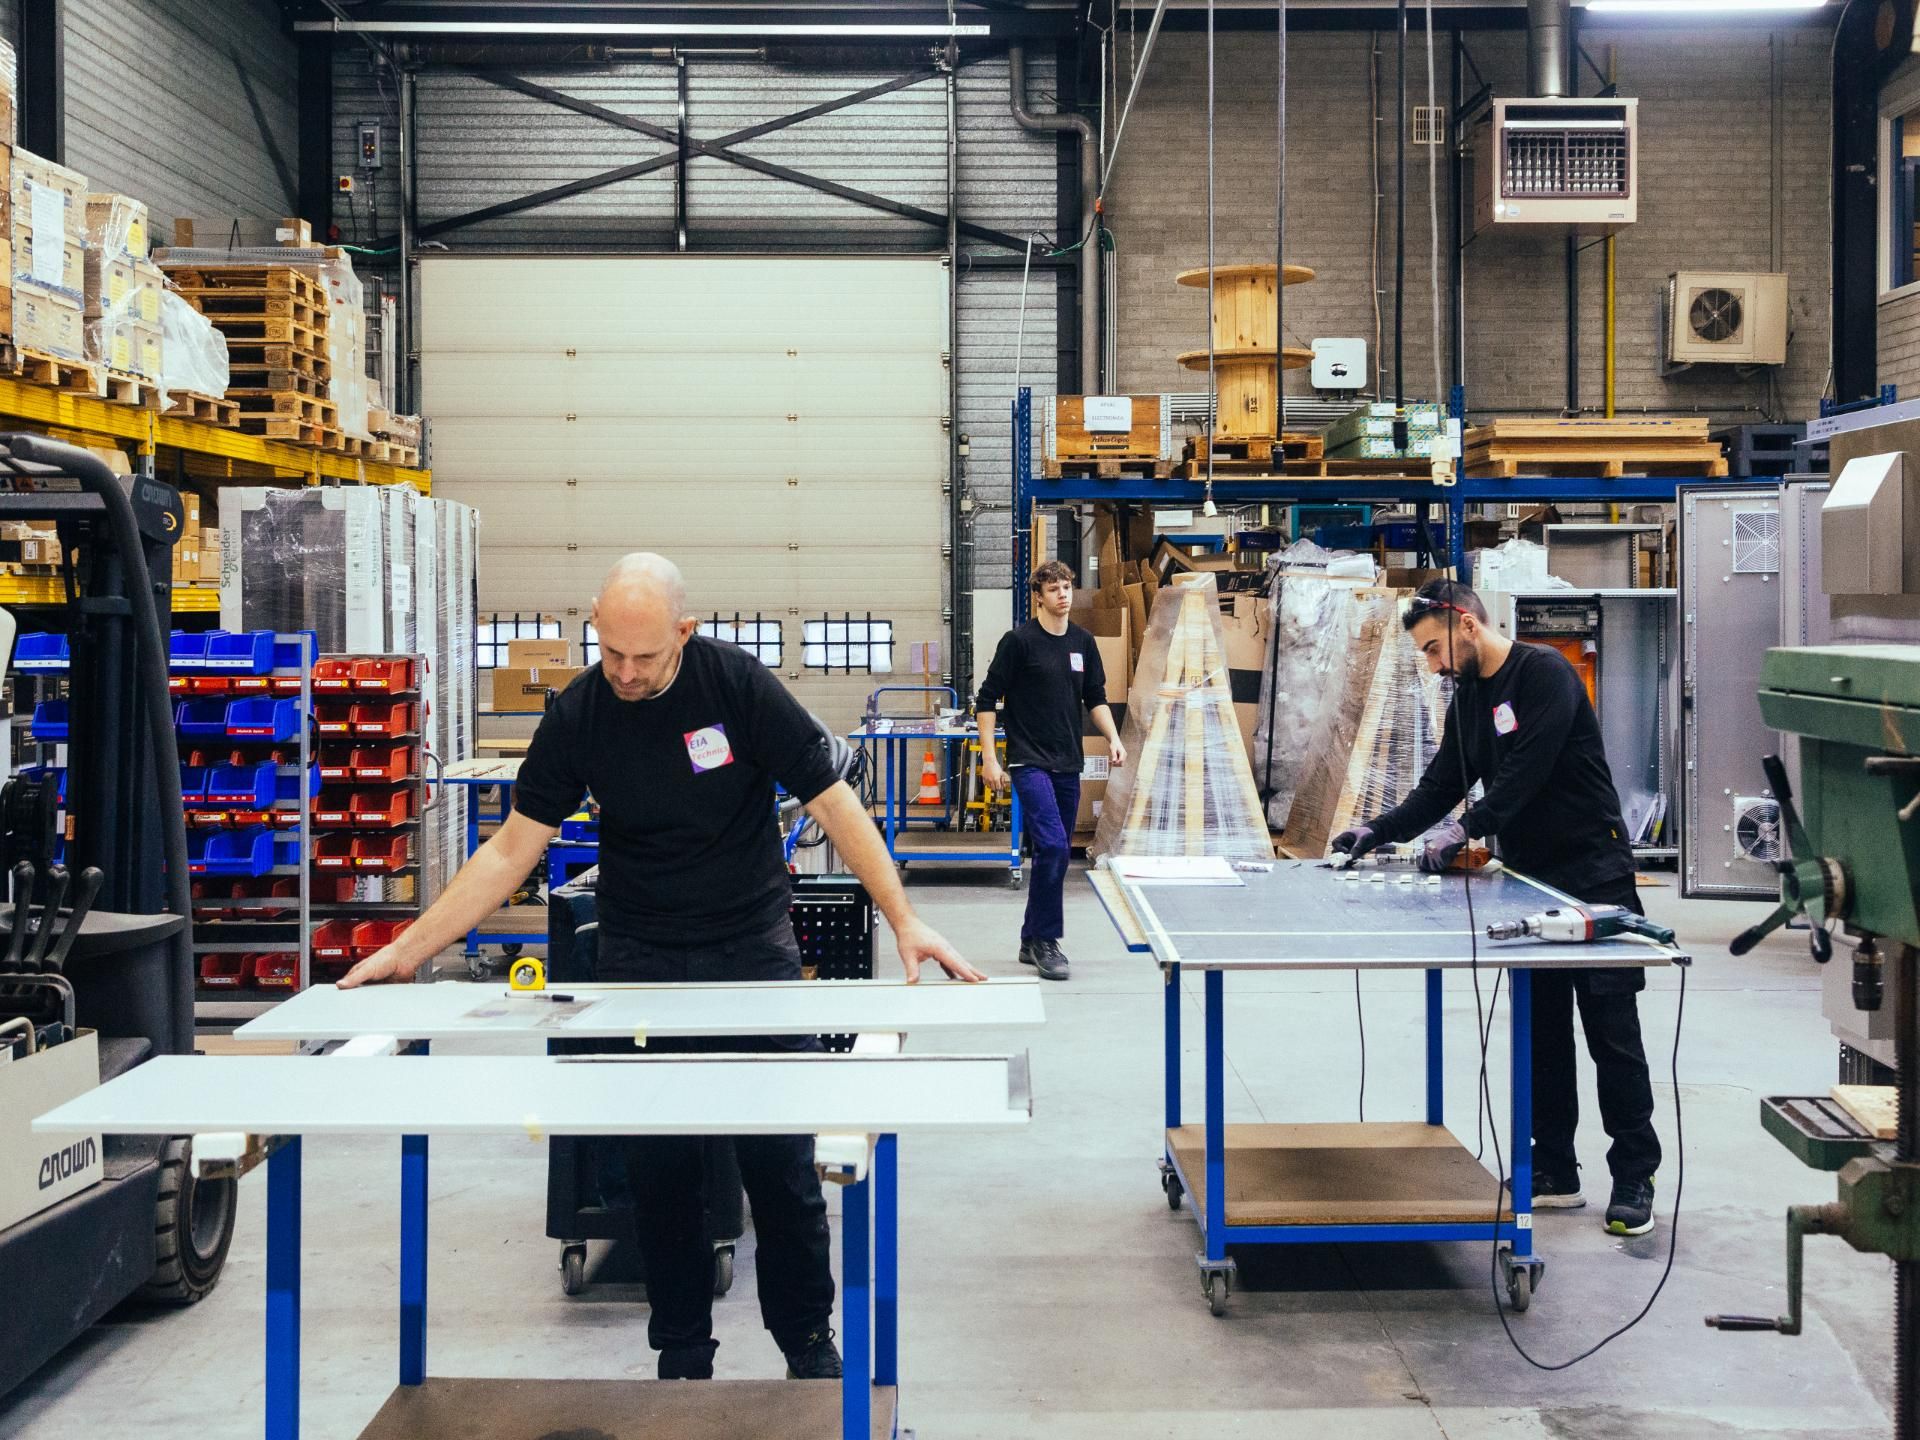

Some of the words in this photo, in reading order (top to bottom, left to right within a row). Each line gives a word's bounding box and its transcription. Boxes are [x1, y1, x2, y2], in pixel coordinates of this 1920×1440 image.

[220, 528, 231, 588] Schneider
[690, 736, 709, 749] EIA
[38, 1136, 96, 1190] CROWN
